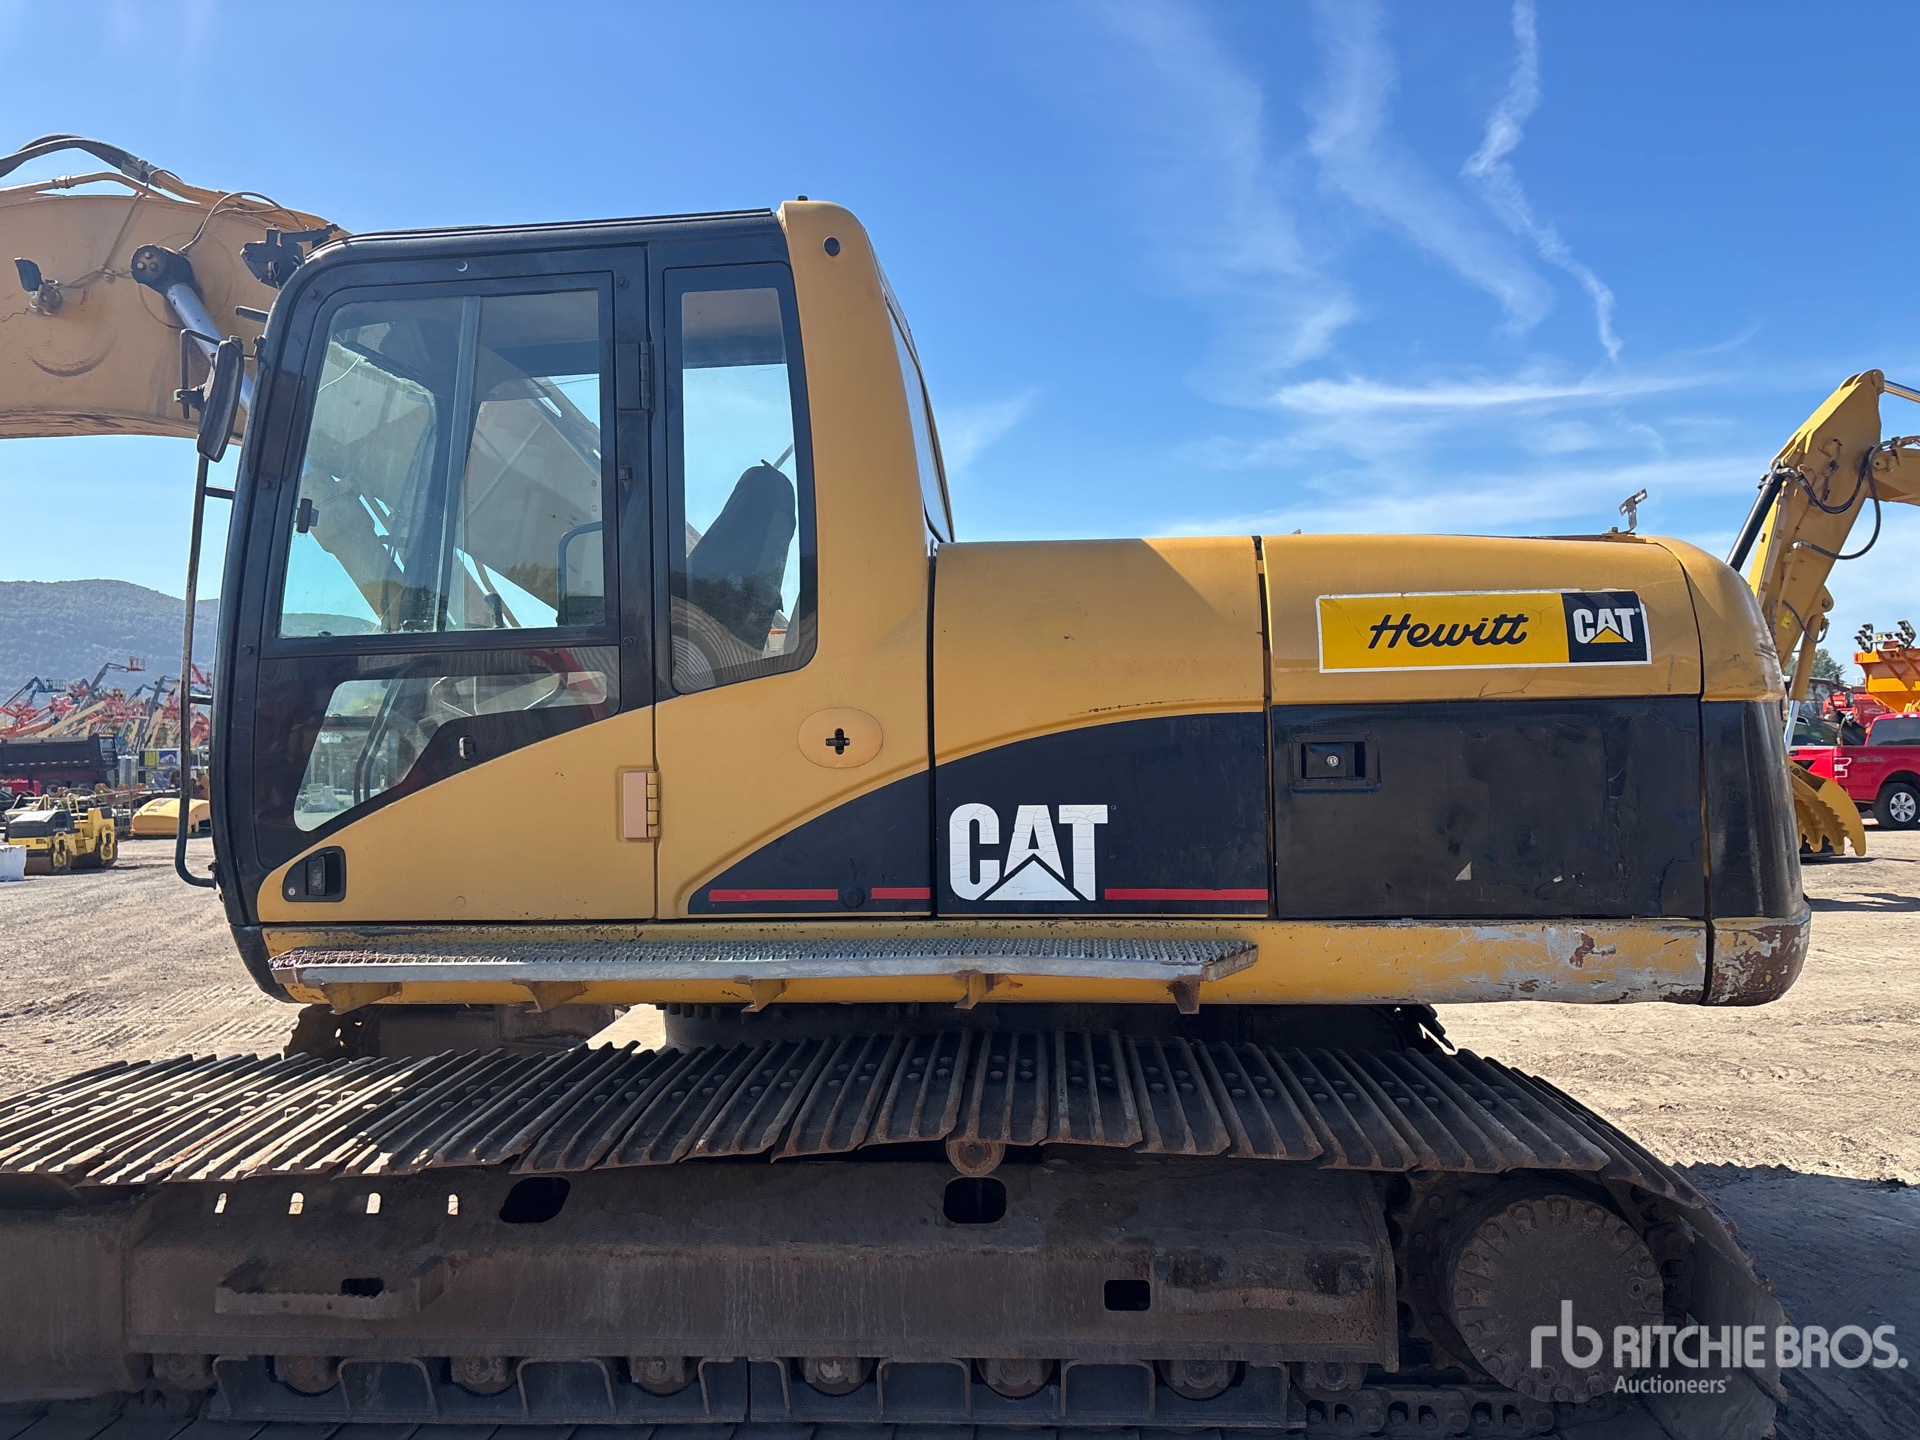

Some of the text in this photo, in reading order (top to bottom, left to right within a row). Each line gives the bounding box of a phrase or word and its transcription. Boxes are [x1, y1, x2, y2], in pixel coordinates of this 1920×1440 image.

[1368, 614, 1528, 649] Hewitt
[1573, 608, 1635, 644] CAT
[949, 803, 1109, 901] CAT
